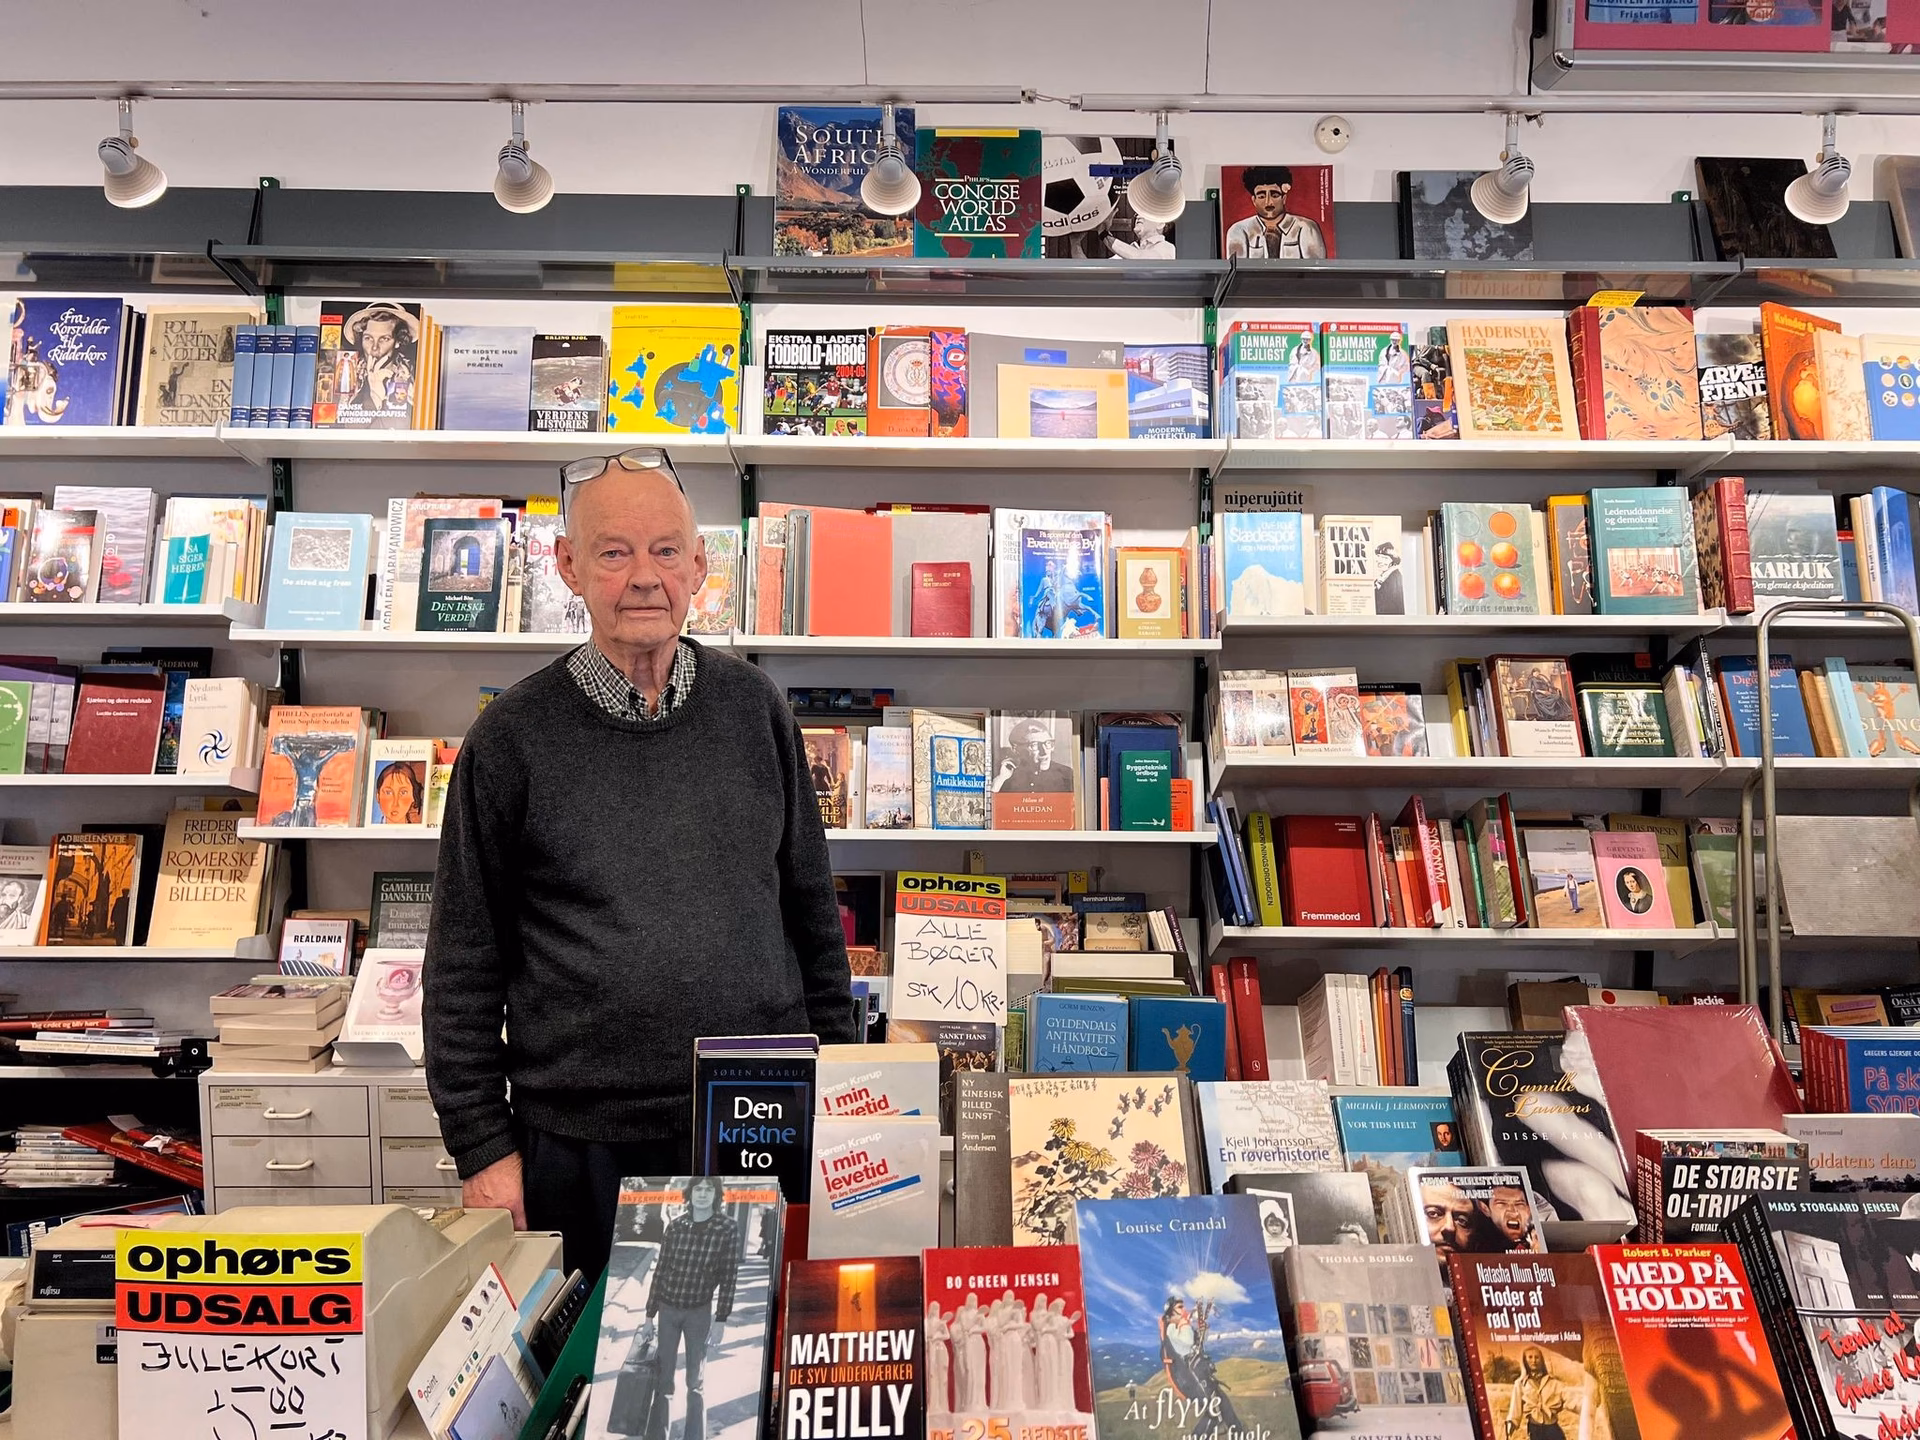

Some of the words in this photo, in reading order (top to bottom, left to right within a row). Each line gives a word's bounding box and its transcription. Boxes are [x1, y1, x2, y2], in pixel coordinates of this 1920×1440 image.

[802, 166, 865, 175] WONDERFUL
[935, 184, 1020, 200] CONCISE
[939, 201, 1016, 216] WORLD
[949, 216, 1007, 232] ATLAS
[1043, 208, 1099, 228] adidas
[60, 307, 90, 324] Fra
[50, 321, 110, 339] Korsridder
[164, 320, 203, 334] POUL
[1462, 326, 1549, 338] HADERSLEV
[163, 333, 218, 348] MARTIN
[768, 335, 812, 344] EKSTRA
[816, 335, 866, 344] BLADETS
[1240, 336, 1288, 349] DANMARK
[1330, 337, 1377, 349] DANMARK
[1464, 339, 1487, 347] 1292
[1528, 340, 1551, 348] 1942
[48, 349, 108, 366] Ridderkors
[1240, 349, 1286, 361] DEJLIGST
[1330, 350, 1374, 362] DEJLIGST
[836, 366, 866, 377] 2004-05
[1701, 365, 1754, 385] ARVE
[211, 379, 232, 393] EN
[177, 394, 231, 408] DANSK
[537, 410, 589, 420] VERDENS
[537, 420, 589, 429] HISTORIEN
[1224, 490, 1304, 508] niperujûtit
[1604, 507, 1673, 517] Lederuddannelse
[1605, 517, 1616, 525] og
[1618, 515, 1658, 524] demokrati
[1327, 527, 1370, 542] TEGN
[179, 553, 203, 563] SIGER
[1331, 544, 1366, 558] VER
[1335, 560, 1367, 575] DEN
[1751, 561, 1833, 579] KARLUK
[1752, 580, 1767, 589] Den
[1768, 580, 1791, 591] glemte
[1793, 580, 1834, 590] ekspedition
[431, 602, 455, 612] DEN
[456, 602, 485, 611] IRSKE
[437, 612, 478, 622] VERDEN
[190, 684, 202, 692] Ny
[203, 683, 223, 691] dansk
[189, 694, 207, 703] Lyrik
[1862, 718, 1920, 731] SLANG
[1126, 764, 1168, 772] Byggeteknisk
[1617, 823, 1645, 832] THOMAS
[60, 834, 72, 842] AD
[73, 834, 107, 842] BIBELENS
[183, 832, 245, 846] POULSEN
[165, 851, 259, 867] ROMERSKE
[176, 869, 249, 884] KULTUR-
[381, 883, 431, 892] GAMMELT
[903, 876, 1001, 896] ophørs
[169, 886, 247, 902] BILLEDER
[381, 893, 414, 902] DANSK
[415, 893, 433, 902] TIN
[901, 896, 1001, 915] UDSALG
[389, 908, 421, 919] Danske
[1302, 911, 1360, 921] Fremmedord
[915, 919, 987, 940] ALLE
[293, 935, 342, 943] REALDANIA
[901, 942, 998, 969] BØGER
[1693, 996, 1724, 1006] Jackie
[1046, 1017, 1116, 1031] GYLDENDALS
[1046, 1031, 1116, 1045] ANTIKVITETS
[1052, 1043, 1108, 1056] HÅNDBOG
[714, 1069, 752, 1077] SØREN
[760, 1069, 806, 1077] KRARUP
[850, 1070, 882, 1086] Krarup
[1481, 1048, 1577, 1097] Camille
[1864, 1066, 1890, 1091] På
[962, 1079, 974, 1087] NY
[823, 1097, 831, 1112] I
[835, 1087, 870, 1108] min
[962, 1089, 1003, 1098] KINESISK
[734, 1097, 783, 1120] Den
[962, 1101, 991, 1109] BILLED
[1394, 1102, 1448, 1111] LERMONTOV
[1505, 1094, 1591, 1118] Laurens
[962, 1112, 993, 1120] KUNST
[1348, 1121, 1367, 1129] VOR
[1370, 1121, 1390, 1129] TIDS
[1393, 1121, 1417, 1129] HELT
[718, 1121, 797, 1144] kristne
[962, 1132, 978, 1141] Sven
[1502, 1132, 1549, 1140] DISSE
[817, 1143, 846, 1158] Søren
[848, 1132, 882, 1148] Krarup
[962, 1143, 997, 1152] Andersen
[1226, 1137, 1250, 1148] Kjell
[1253, 1137, 1313, 1147] Johansson
[741, 1148, 773, 1168] tro
[1219, 1148, 1236, 1162] En
[1241, 1146, 1330, 1161] røverhistorie
[1810, 1152, 1874, 1170] oldatens
[1880, 1152, 1916, 1168] dans
[820, 1160, 828, 1176] I
[833, 1150, 869, 1172] min
[825, 1158, 889, 1193] levetid
[1673, 1165, 1700, 1189] DE
[1705, 1165, 1799, 1191] STØRSTE
[1769, 1201, 1796, 1213] MADS
[1800, 1202, 1859, 1214] STORGAARD
[1863, 1203, 1899, 1214] JENSEN
[1116, 1220, 1163, 1235] Louise
[1169, 1217, 1227, 1232] Crandal
[1691, 1223, 1718, 1232] FORTALT
[128, 1240, 352, 1279] ophørs
[1319, 1256, 1364, 1264] THOMAS
[1368, 1255, 1414, 1264] BOBERG
[1623, 1248, 1660, 1258] Robert
[1662, 1248, 1673, 1257] B.
[1675, 1248, 1711, 1258] Parker
[1477, 1262, 1511, 1285] Natasha
[1533, 1266, 1556, 1288] Berg
[1611, 1263, 1685, 1285] MED
[1693, 1254, 1739, 1284] PÅ
[946, 1276, 962, 1289] BO
[968, 1274, 1008, 1288] GREEN
[1014, 1273, 1060, 1287] JENSEN
[40, 1286, 60, 1296] FUJITSU
[1483, 1286, 1526, 1308] Floder
[1530, 1288, 1543, 1306] af
[1618, 1286, 1744, 1311] HOLDET
[127, 1291, 352, 1325] UDSALG
[1487, 1308, 1509, 1329] rød
[1511, 1306, 1541, 1332] jord
[1884, 1309, 1905, 1338] at
[1564, 1333, 1581, 1341] Afrika
[790, 1329, 915, 1365] MATTHEW
[141, 1338, 344, 1384] JULEKORT
[790, 1369, 804, 1386] DE
[807, 1367, 828, 1385] SYV
[831, 1363, 913, 1383] UNDERVÆRKER
[1836, 1367, 1894, 1413] Grace
[787, 1384, 913, 1440] REILLY
[1124, 1400, 1148, 1420] At
[1149, 1387, 1222, 1429] flyve
[961, 1418, 1011, 1440] 25
[1182, 1424, 1217, 1440] med
[1227, 1423, 1270, 1440] fugle
